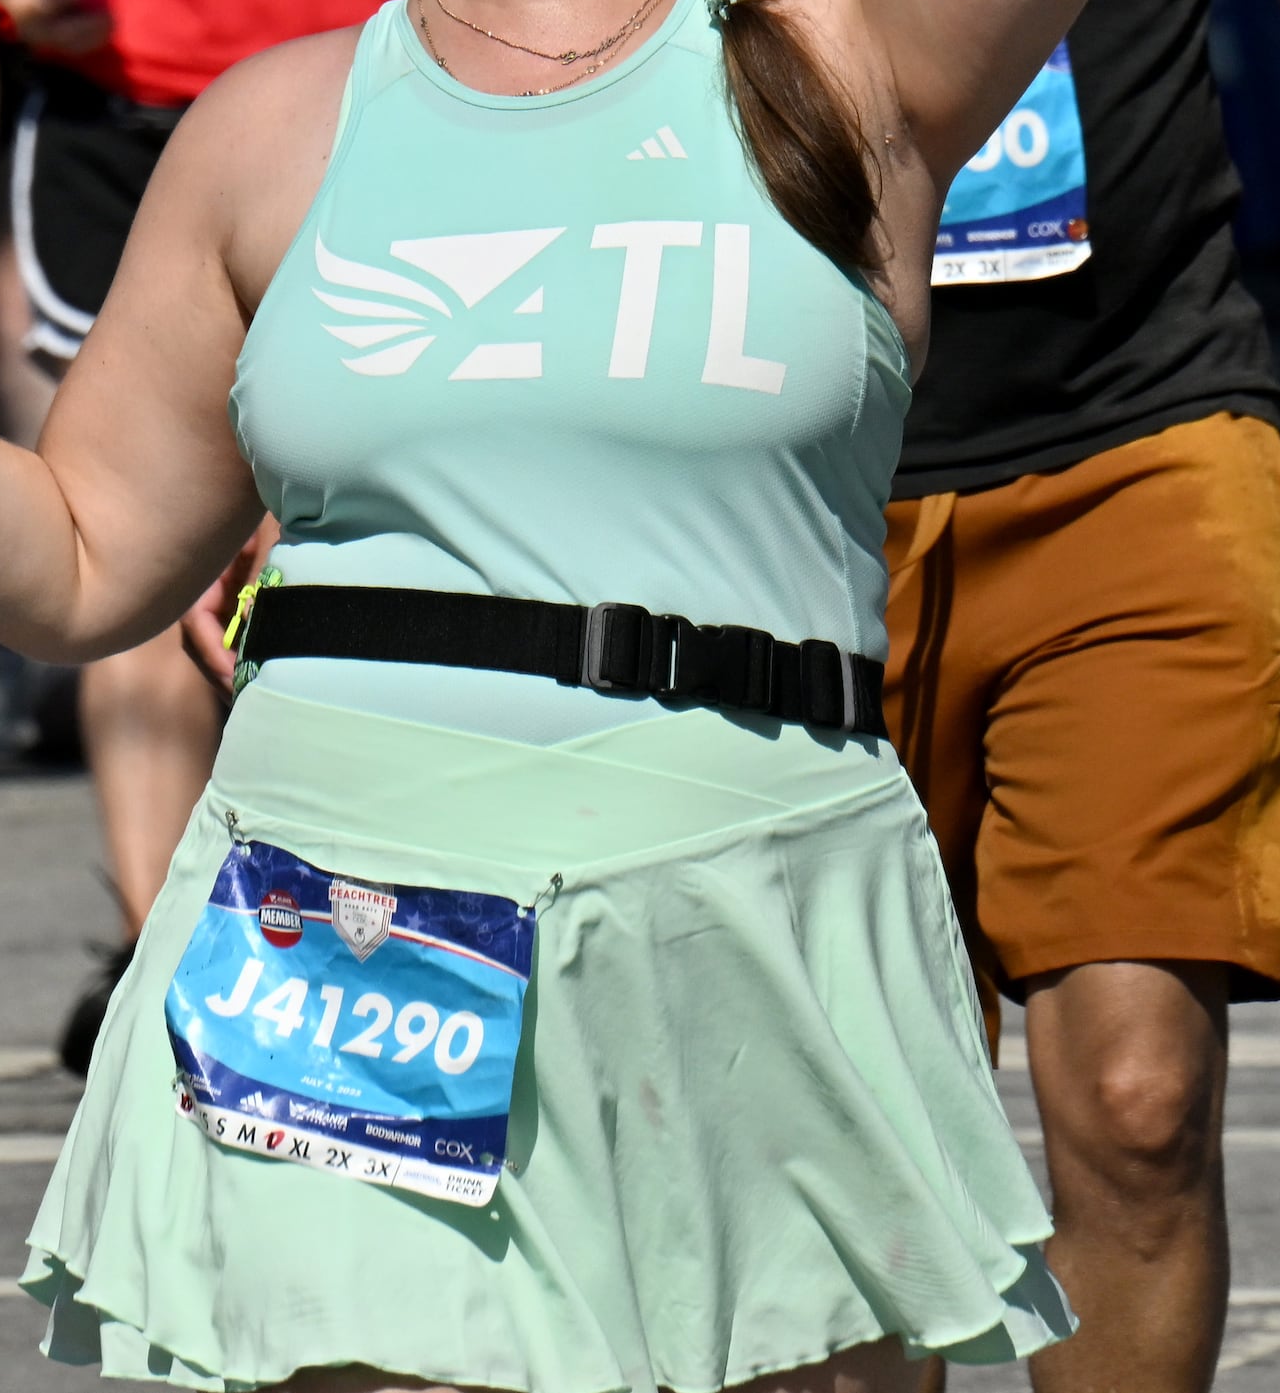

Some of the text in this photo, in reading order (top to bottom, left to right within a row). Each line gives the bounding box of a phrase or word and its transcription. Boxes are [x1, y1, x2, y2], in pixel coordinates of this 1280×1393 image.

[329, 887, 397, 910] PEACHTREE
[260, 909, 302, 930] MEMBER
[204, 956, 485, 1076] J41290
[301, 1075, 324, 1088] JULY
[216, 1117, 227, 1137] S
[237, 1123, 256, 1145] M
[289, 1138, 311, 1160] XL
[325, 1148, 353, 1170] 2X
[364, 1159, 391, 1178] 3X
[365, 1123, 422, 1149] BODYARMOR
[434, 1138, 475, 1165] COX
[445, 1184, 484, 1198] TICKET
[447, 1174, 484, 1188] DRINK
